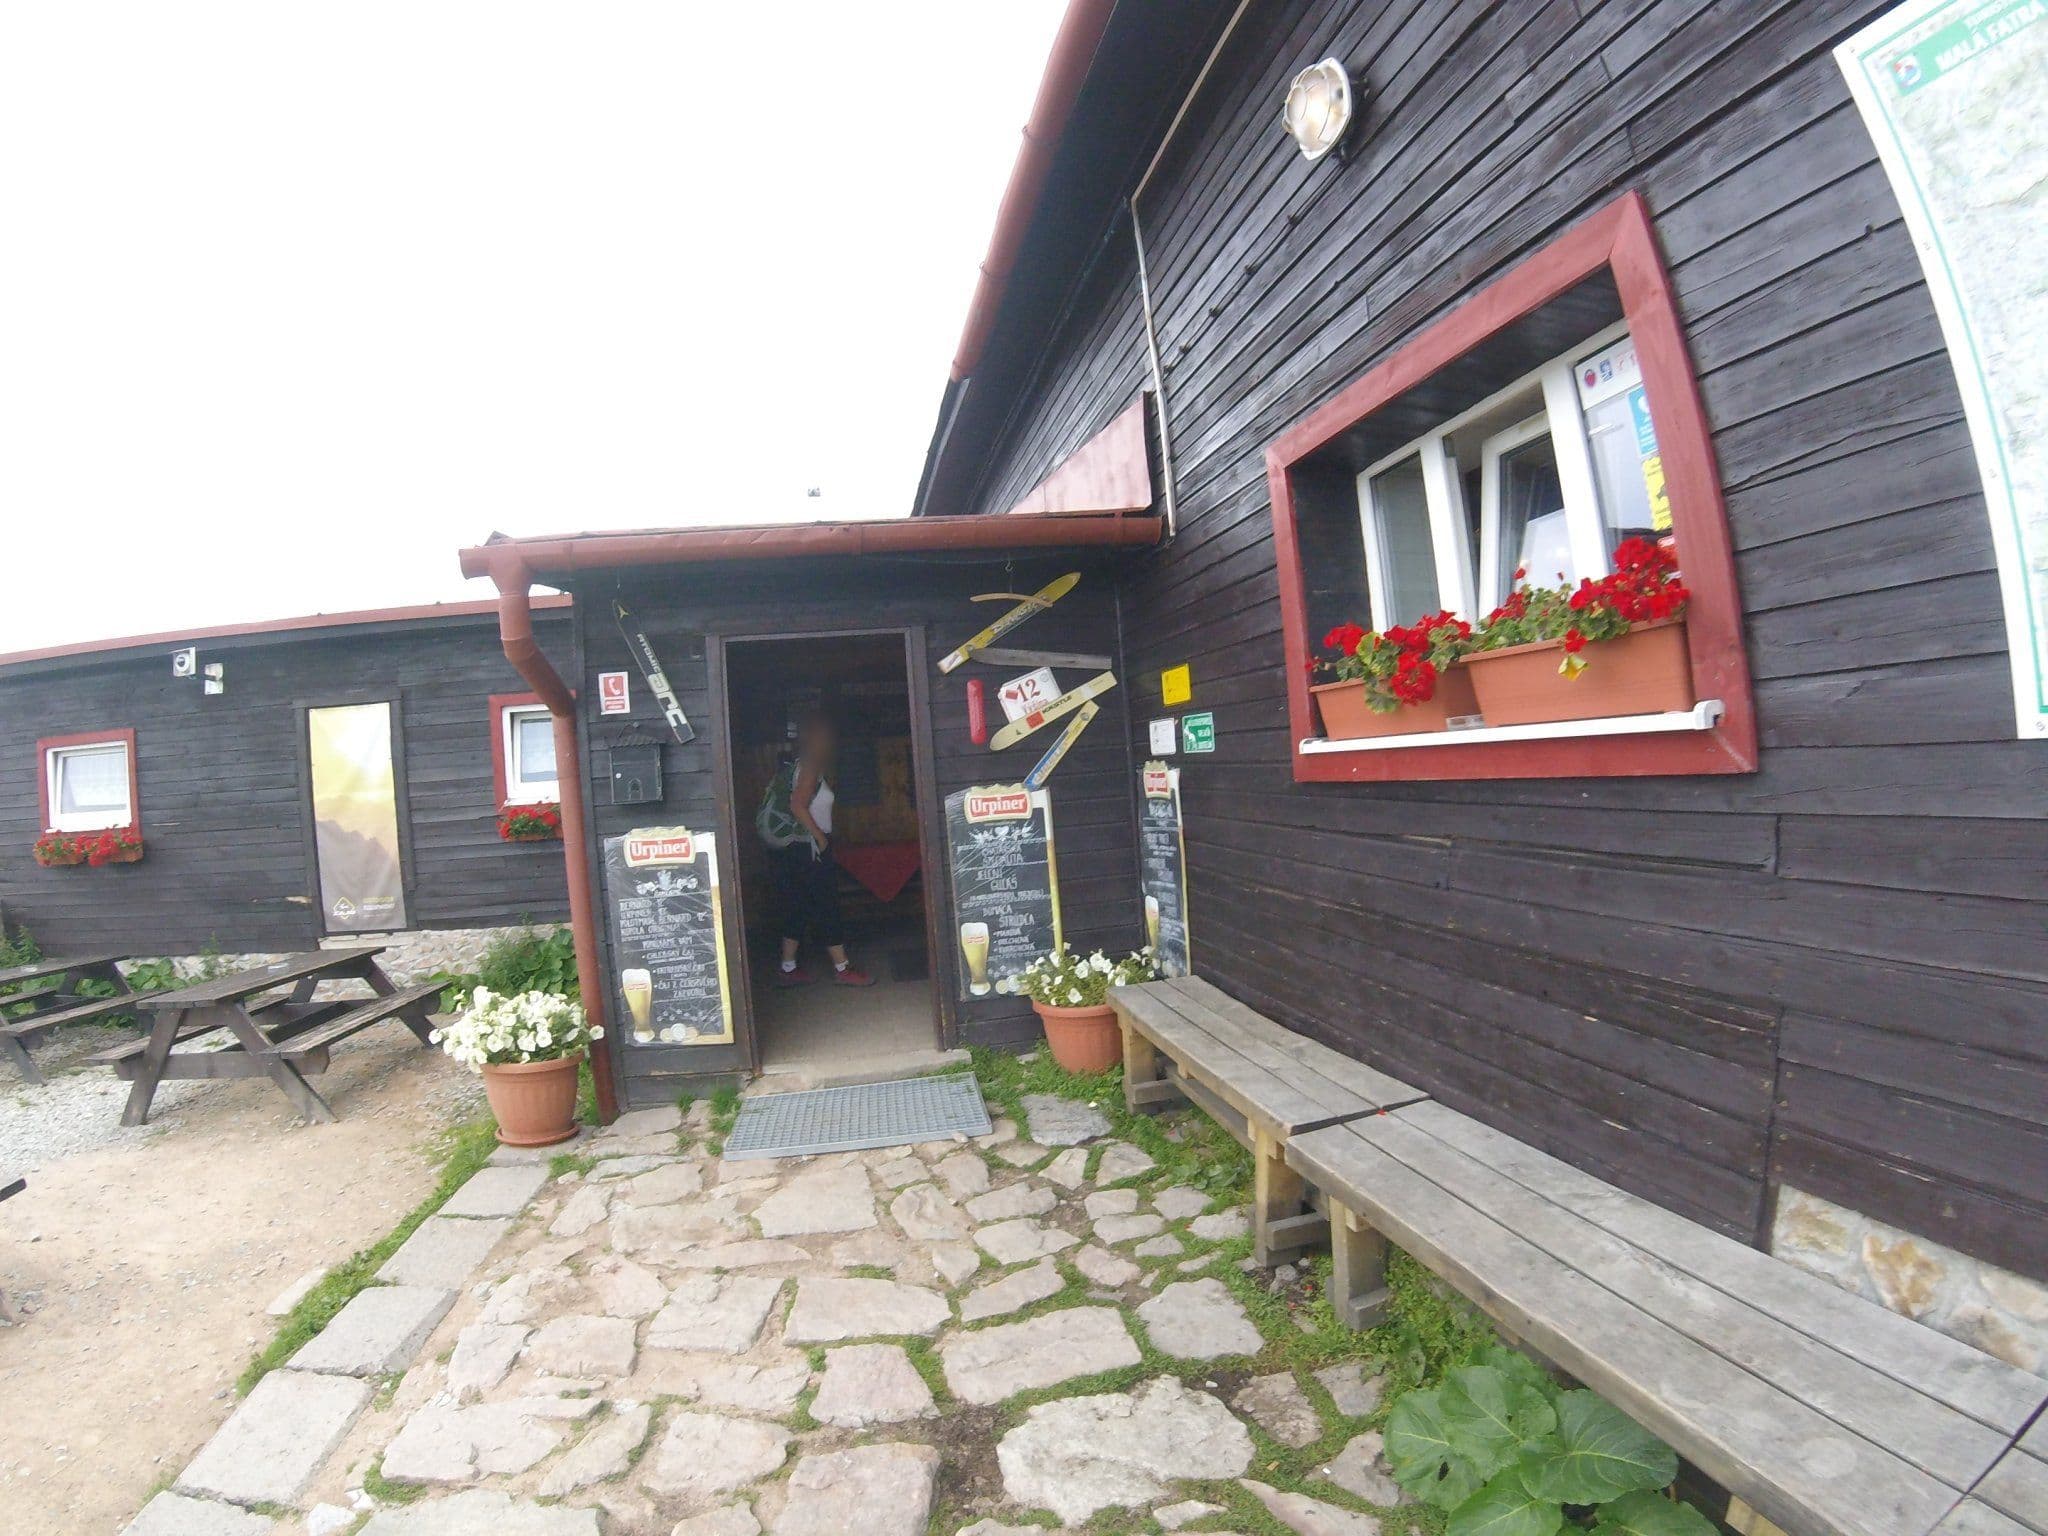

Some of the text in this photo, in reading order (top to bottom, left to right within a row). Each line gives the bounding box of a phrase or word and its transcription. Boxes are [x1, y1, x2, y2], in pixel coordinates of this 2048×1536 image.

[637, 633, 662, 673] ATOMIC
[1017, 679, 1041, 702] 12
[971, 796, 1026, 816] Urpiner
[631, 840, 688, 860] Urpiner
